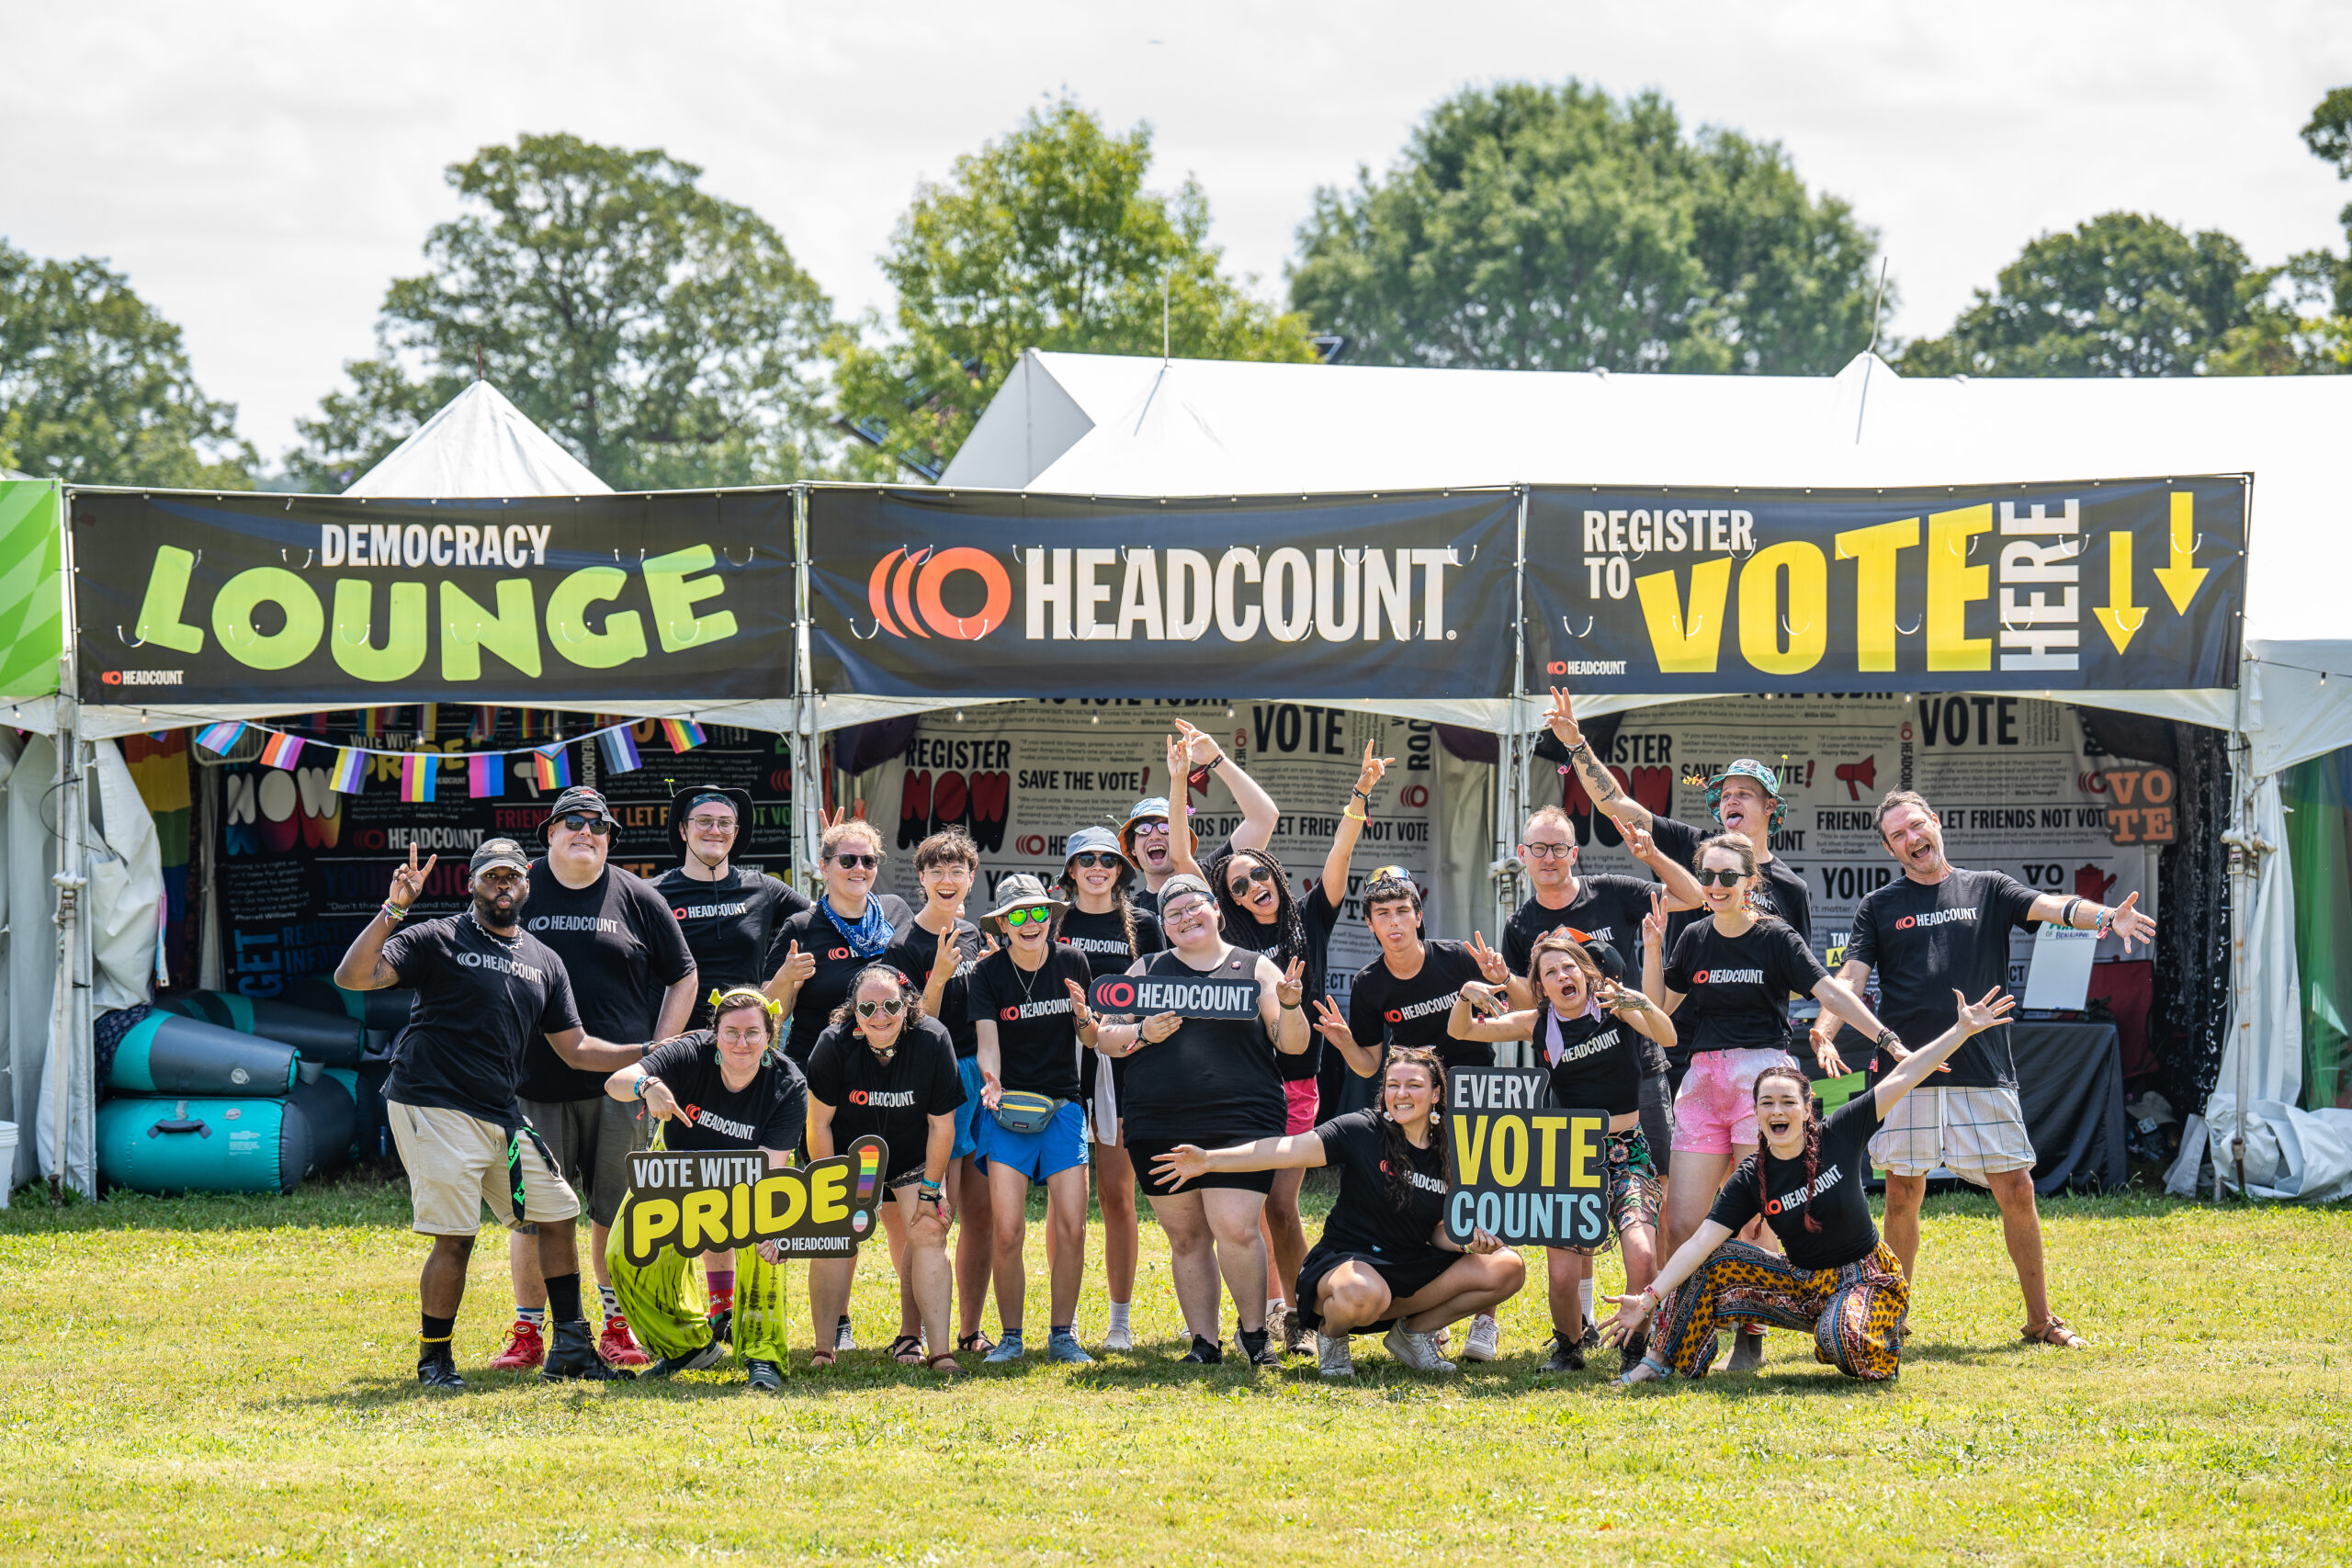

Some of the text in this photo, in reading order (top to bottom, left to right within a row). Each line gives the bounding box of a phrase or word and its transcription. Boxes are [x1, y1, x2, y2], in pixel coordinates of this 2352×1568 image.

[321, 524, 551, 567] DEMOCRACY
[1583, 509, 1754, 552] REGISTER
[1584, 556, 1631, 600] TO
[1634, 502, 1994, 675] VOTE
[1999, 498, 2080, 671] HERE
[135, 543, 738, 682] LOUNGE
[122, 670, 184, 685] HEADCOUNT
[1567, 660, 1627, 676] HEADCOUNT
[1252, 704, 1346, 755] VOTE
[1918, 696, 2018, 746] VOTE
[582, 739, 596, 788] HEADCOU
[905, 739, 1011, 769] REGISTER
[1018, 765, 1150, 795] SAVE THE VOTE!
[2105, 770, 2172, 805] VO
[227, 767, 341, 827] NOW
[899, 768, 1010, 829] NOW
[627, 808, 656, 827] LET
[1363, 821, 1393, 840] NOT
[1397, 822, 1430, 842] VOTE
[1941, 809, 1966, 829] LET
[1971, 808, 2036, 829] FRIENDS
[2041, 808, 2069, 828] NOT
[2077, 807, 2105, 828] VOT
[2108, 807, 2175, 842] TE
[388, 828, 485, 850] HEADCOUNT
[551, 915, 618, 933] HEADCOUNT
[1917, 907, 1978, 927] HEADCOUNT
[1071, 937, 1130, 955] HEADCOUNT
[234, 929, 283, 998] GET
[483, 953, 543, 984] HEADCOUNT
[1709, 969, 1764, 984] HEADCOUNT
[1137, 983, 1254, 1012] HEADCOUNT
[1401, 990, 1461, 1021] HEADCOUNT
[1561, 1029, 1621, 1063] HEADCOUNT
[868, 1090, 915, 1108] HEADCOUNT
[1454, 1074, 1541, 1109] EVERY
[697, 1111, 755, 1141] HEADCOUNT
[1453, 1114, 1602, 1188] VOTE
[633, 1157, 763, 1188] VOTE WITH
[632, 1145, 880, 1258] PRIDE!
[1451, 1190, 1601, 1240] COUNTS
[791, 1237, 851, 1251] HEADCOUNT
